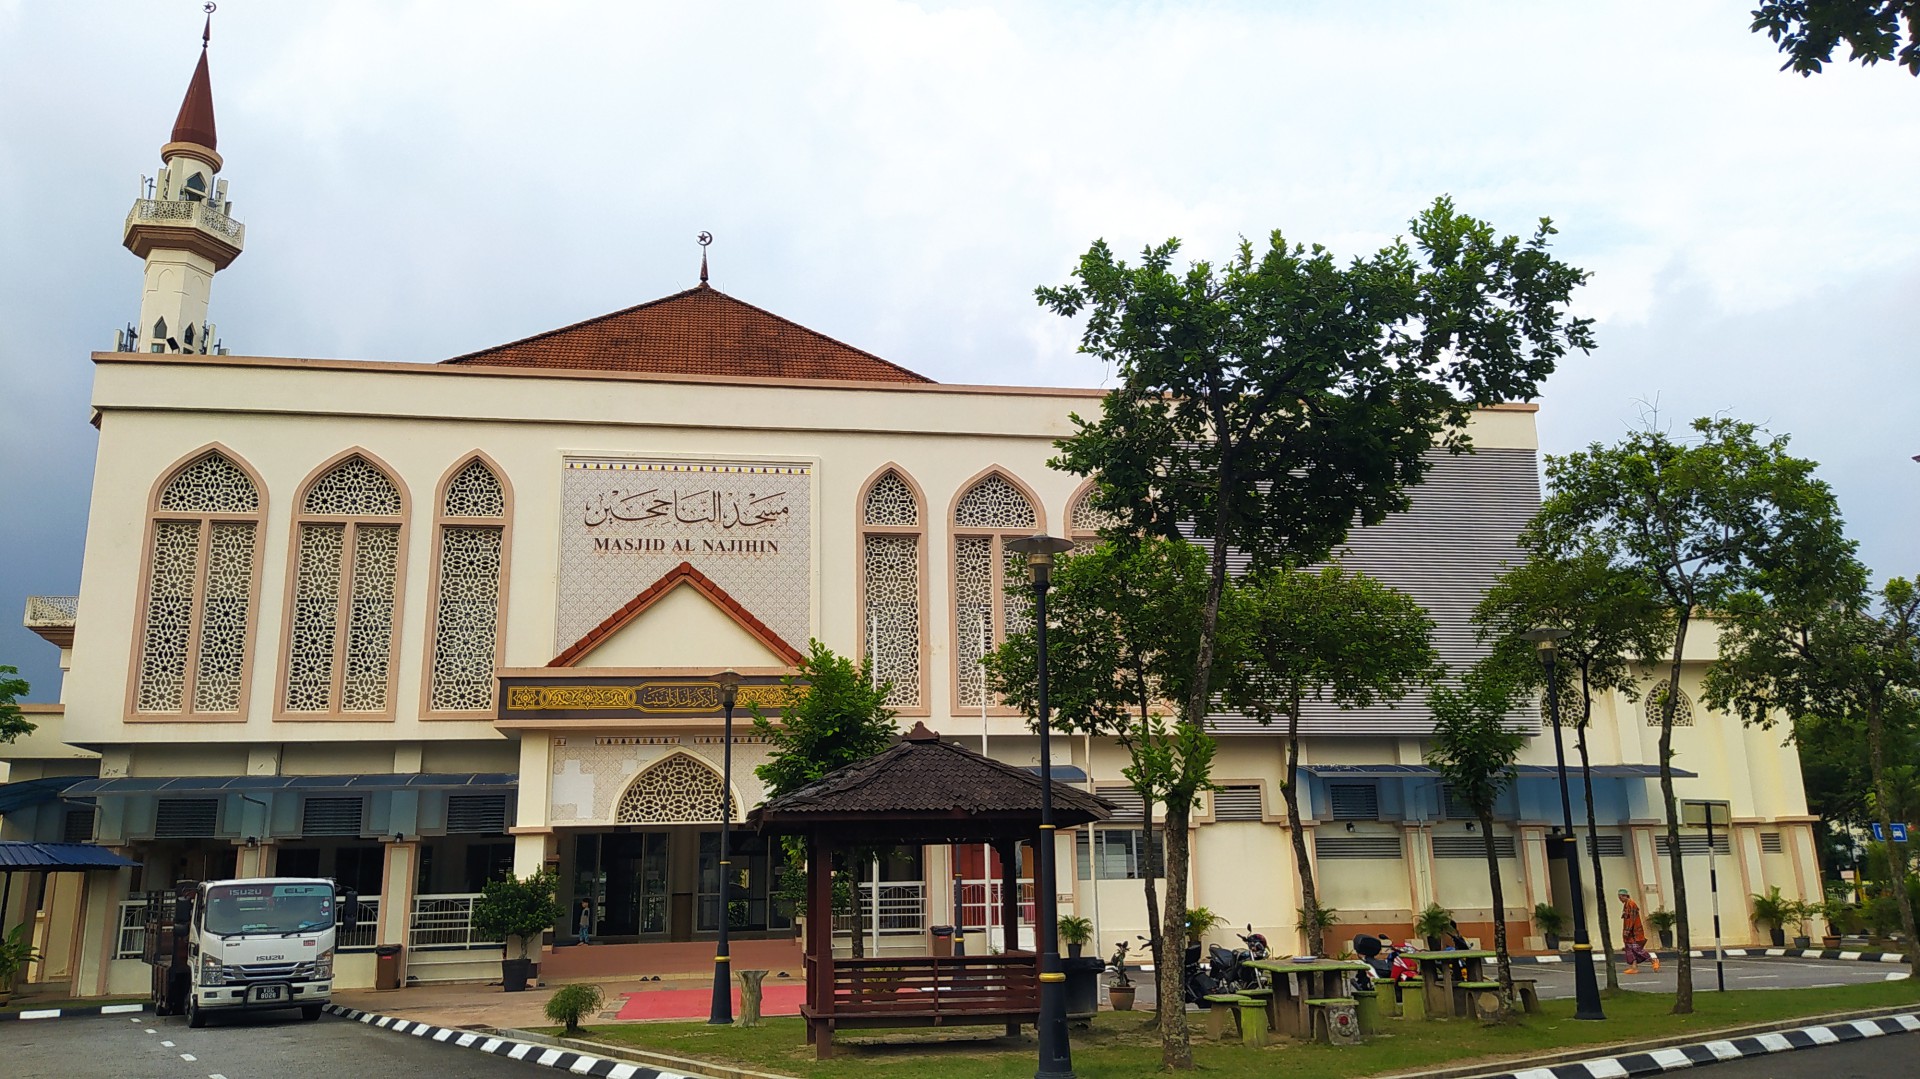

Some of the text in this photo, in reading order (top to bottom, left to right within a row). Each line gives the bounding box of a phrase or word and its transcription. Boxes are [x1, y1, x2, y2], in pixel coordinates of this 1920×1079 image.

[594, 537, 779, 553] MASJID AL NAJIHIN
[229, 888, 262, 896] ISUZU
[256, 954, 285, 962] ISUZU
